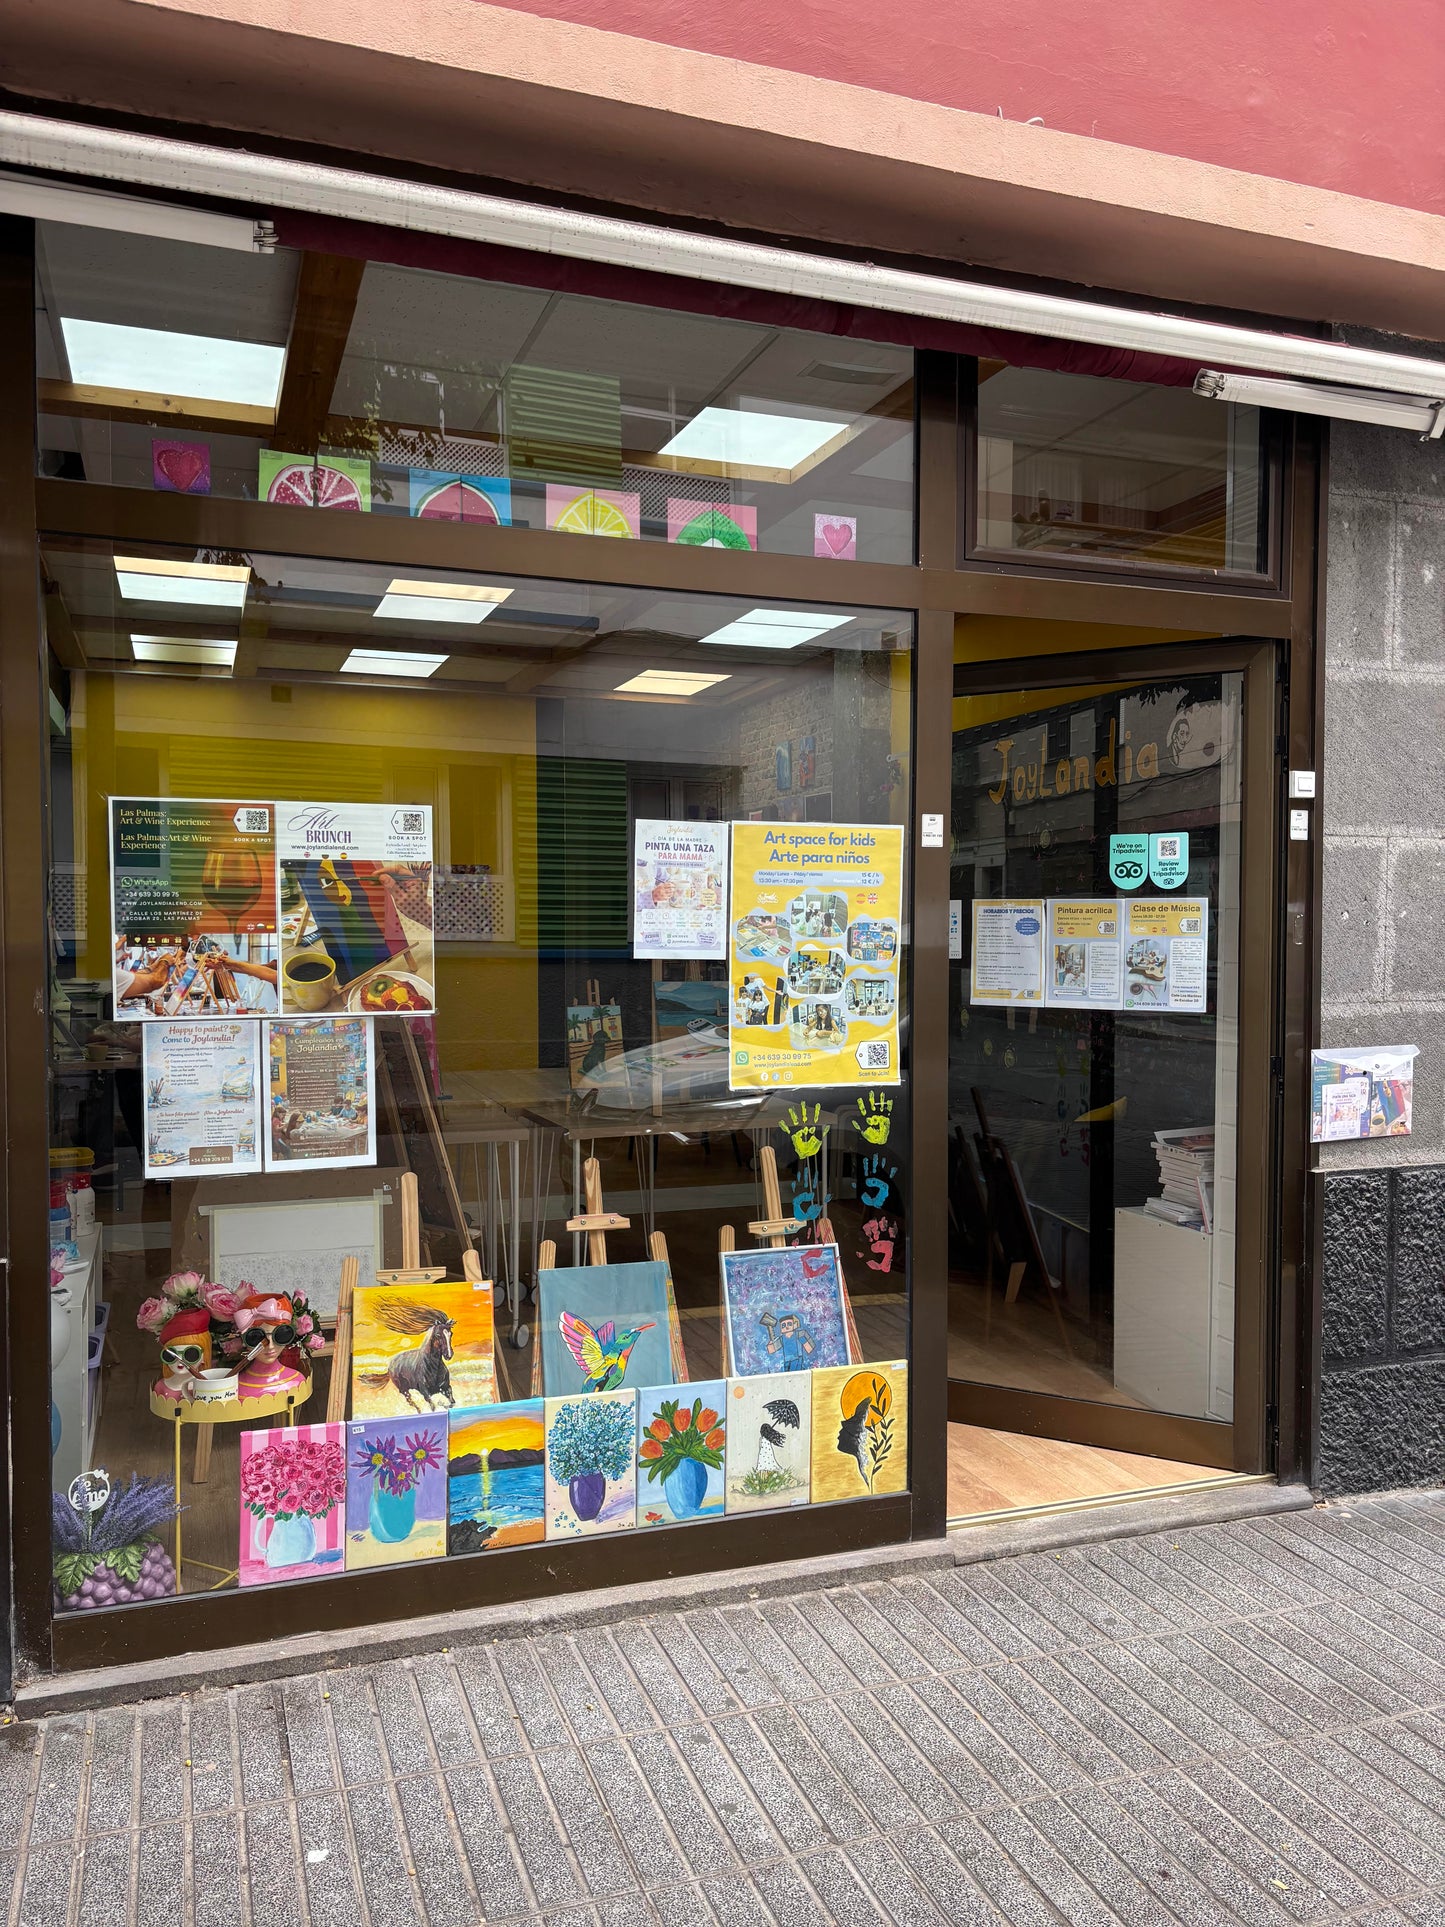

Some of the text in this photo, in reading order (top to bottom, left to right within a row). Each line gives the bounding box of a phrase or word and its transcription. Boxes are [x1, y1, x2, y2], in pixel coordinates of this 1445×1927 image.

[120, 808, 167, 818] Las Palmas:
[120, 817, 211, 828] Art & Wine Experience
[287, 806, 340, 831] Art
[120, 833, 135, 841] Las
[182, 834, 190, 842] &
[191, 834, 212, 842] Wine
[306, 830, 352, 843] BRUNCH
[764, 830, 876, 848] Art space for kids
[121, 842, 167, 850] Experience
[645, 842, 715, 853] PINTA UNA TAZA
[658, 852, 678, 860] PARA
[769, 849, 870, 866] Arte para niños
[134, 879, 169, 887] WhatsApp
[1085, 906, 1113, 914] acrílica
[1158, 904, 1169, 912] de
[1170, 903, 1201, 912] Música
[168, 1026, 193, 1036] Happy
[203, 1025, 229, 1034] paint?
[191, 1034, 235, 1044] Joylandia!
[296, 1043, 338, 1053] Joylandia
